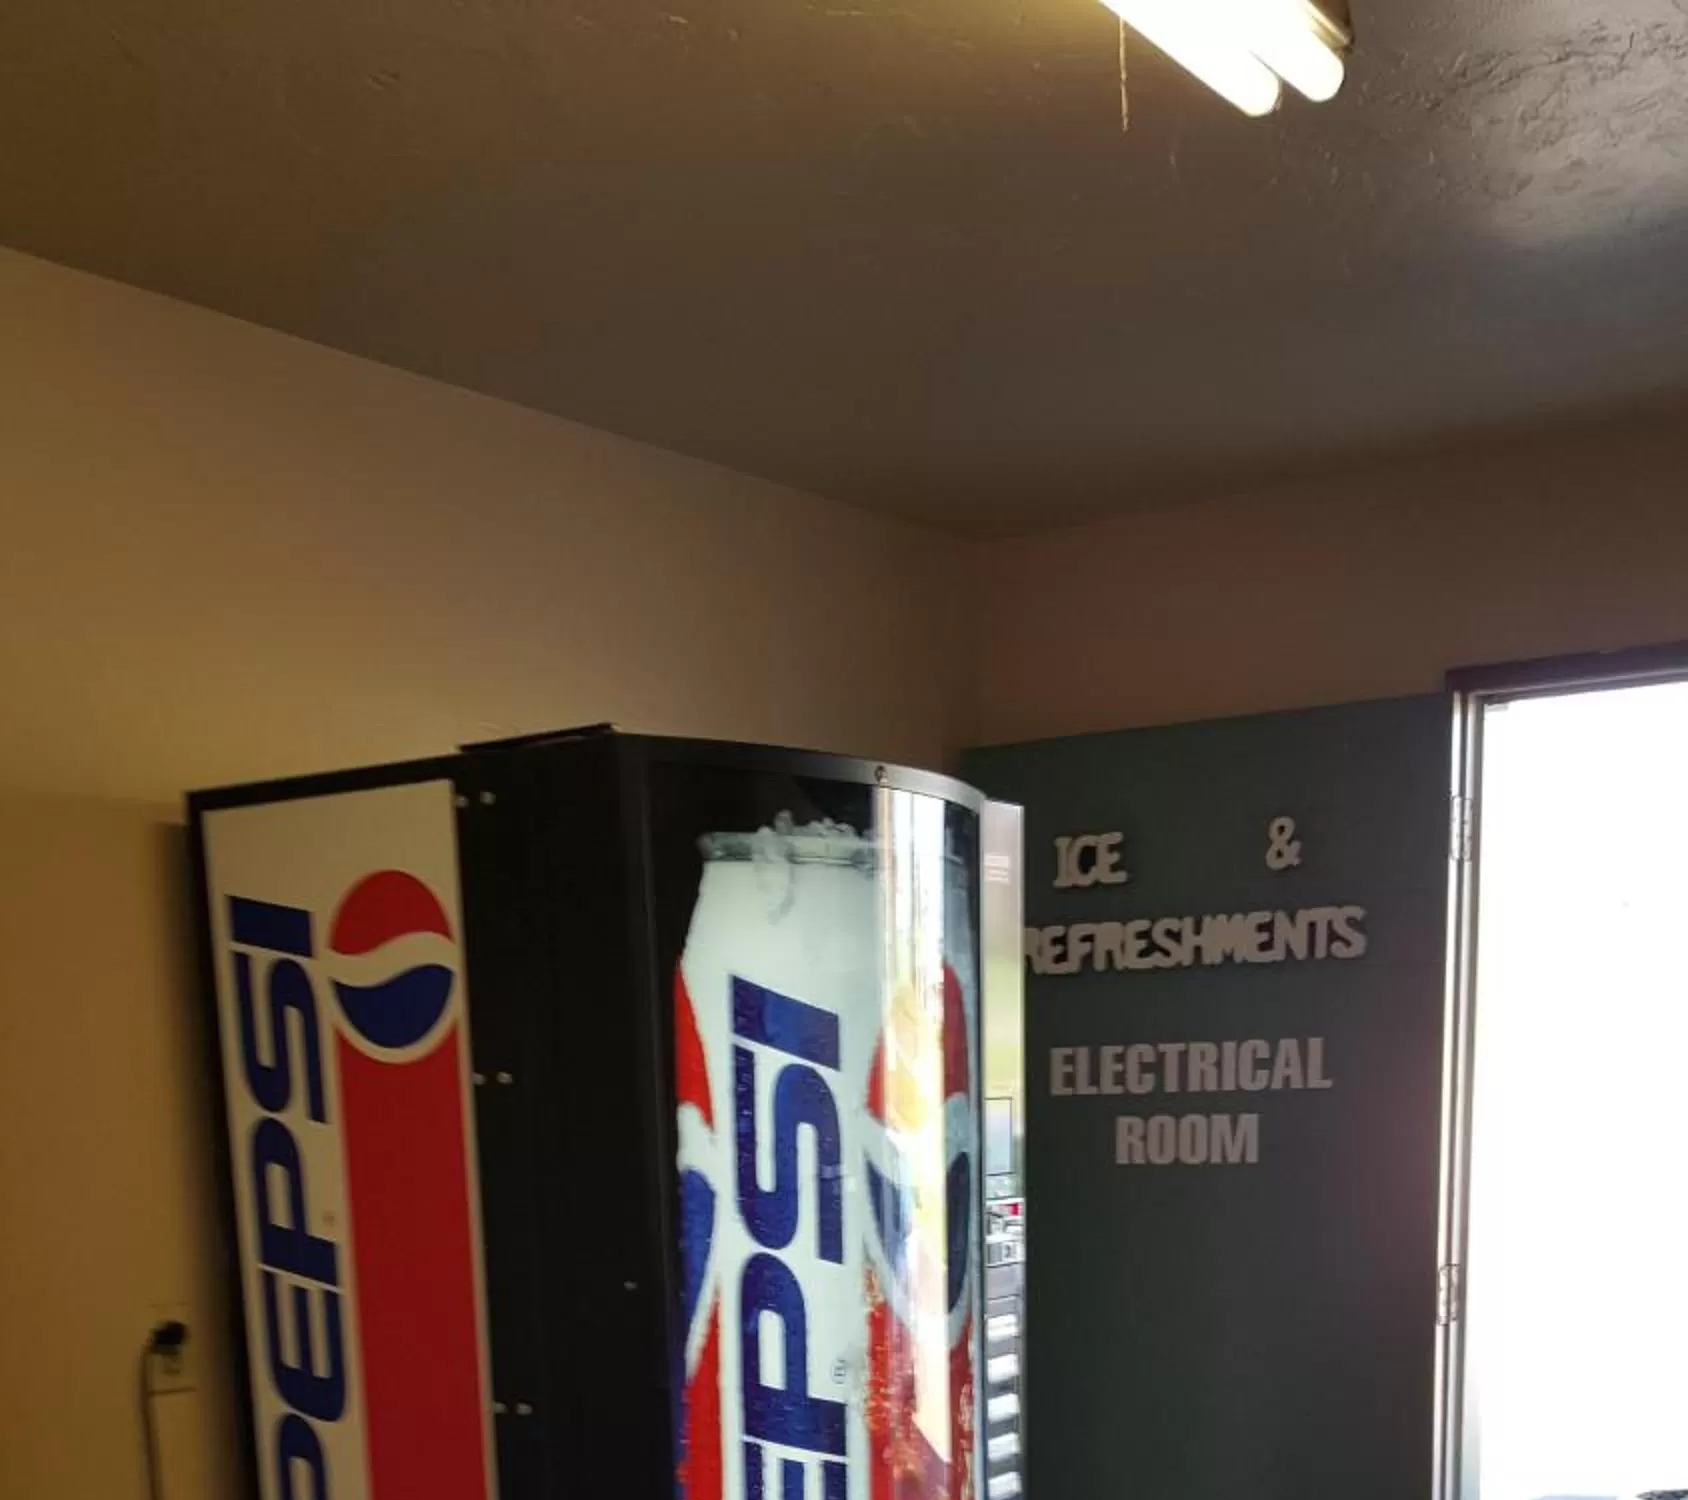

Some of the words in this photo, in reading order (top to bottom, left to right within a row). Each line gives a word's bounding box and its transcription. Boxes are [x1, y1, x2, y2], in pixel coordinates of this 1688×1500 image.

[1052, 832, 1128, 888] ICE
[1265, 816, 1302, 870] &
[1024, 906, 1367, 975] REFRESHMENTS
[1050, 1037, 1332, 1097] ELECTRICAL
[1115, 1113, 1259, 1165] ROOM
